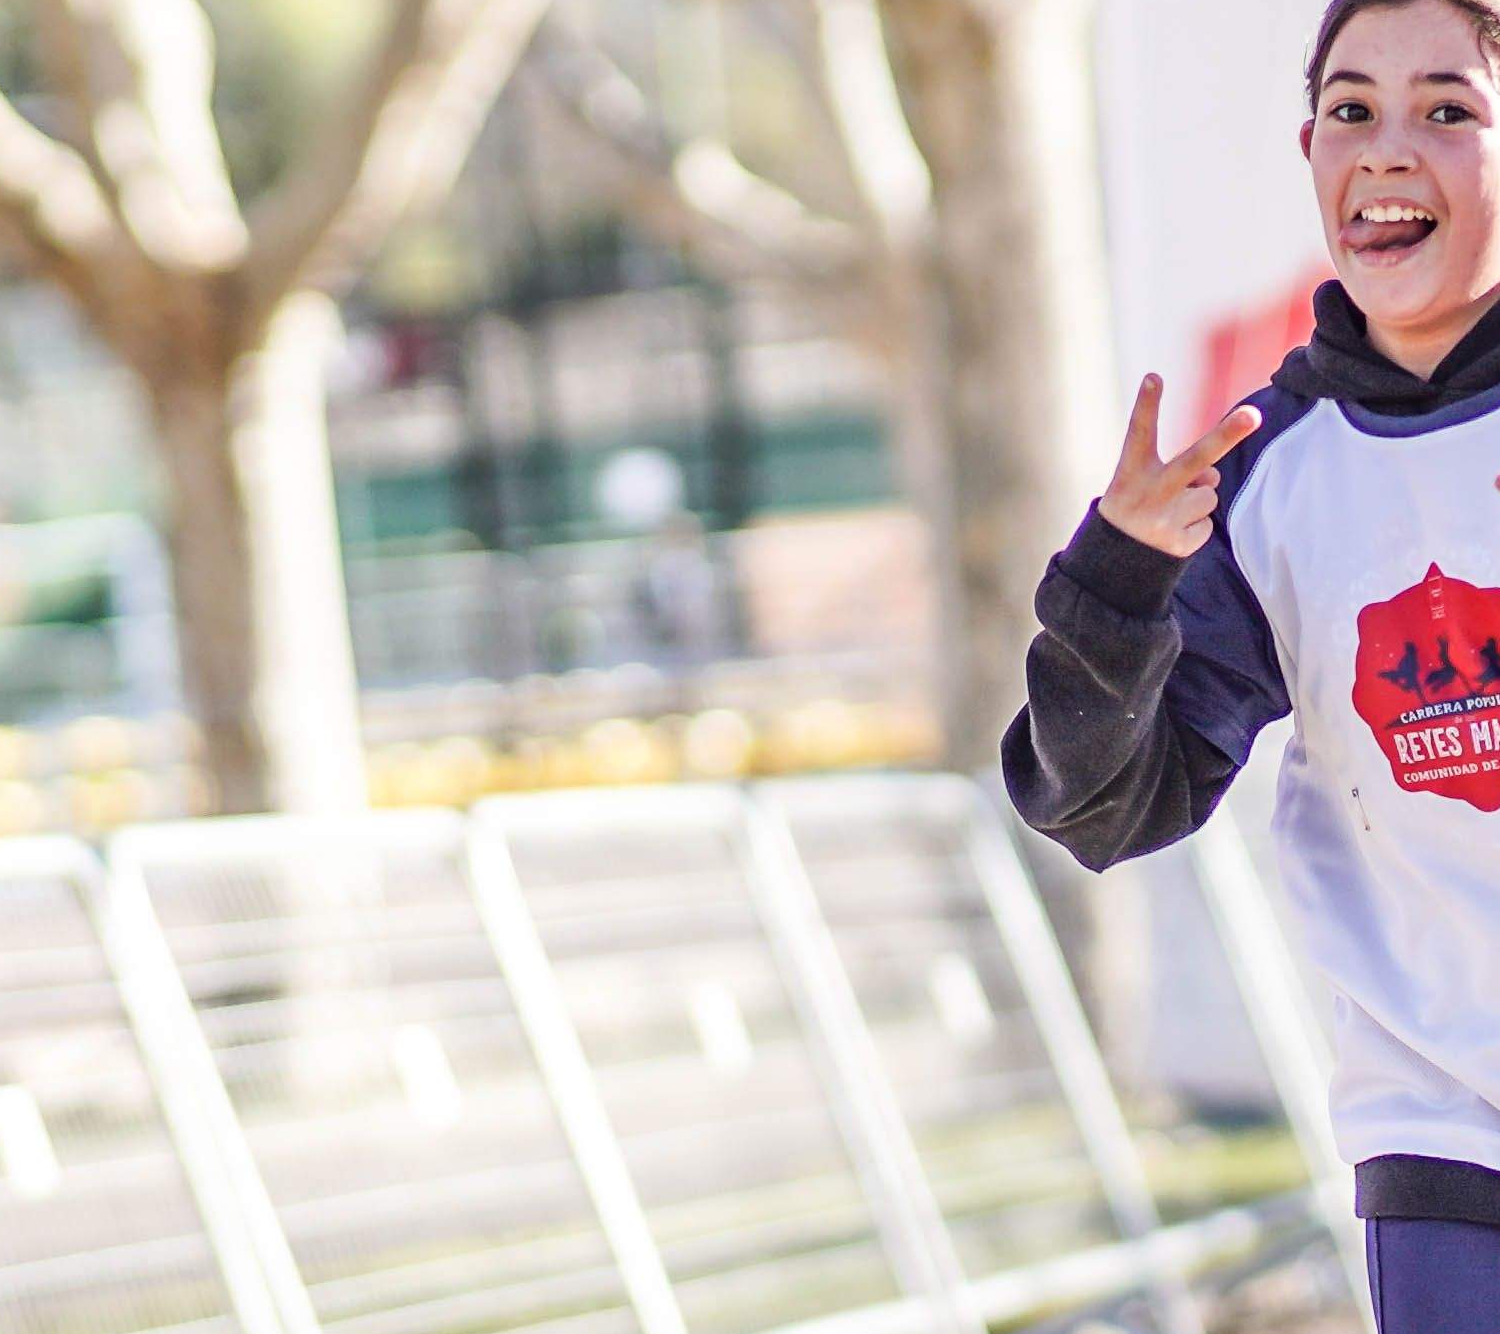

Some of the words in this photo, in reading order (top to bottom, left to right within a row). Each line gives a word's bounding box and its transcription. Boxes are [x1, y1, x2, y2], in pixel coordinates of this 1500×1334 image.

[1400, 701, 1463, 724] CARRERA
[1393, 726, 1463, 764] REYES
[1403, 763, 1479, 784] COMUNIDAD
[1481, 759, 1500, 772] DE
